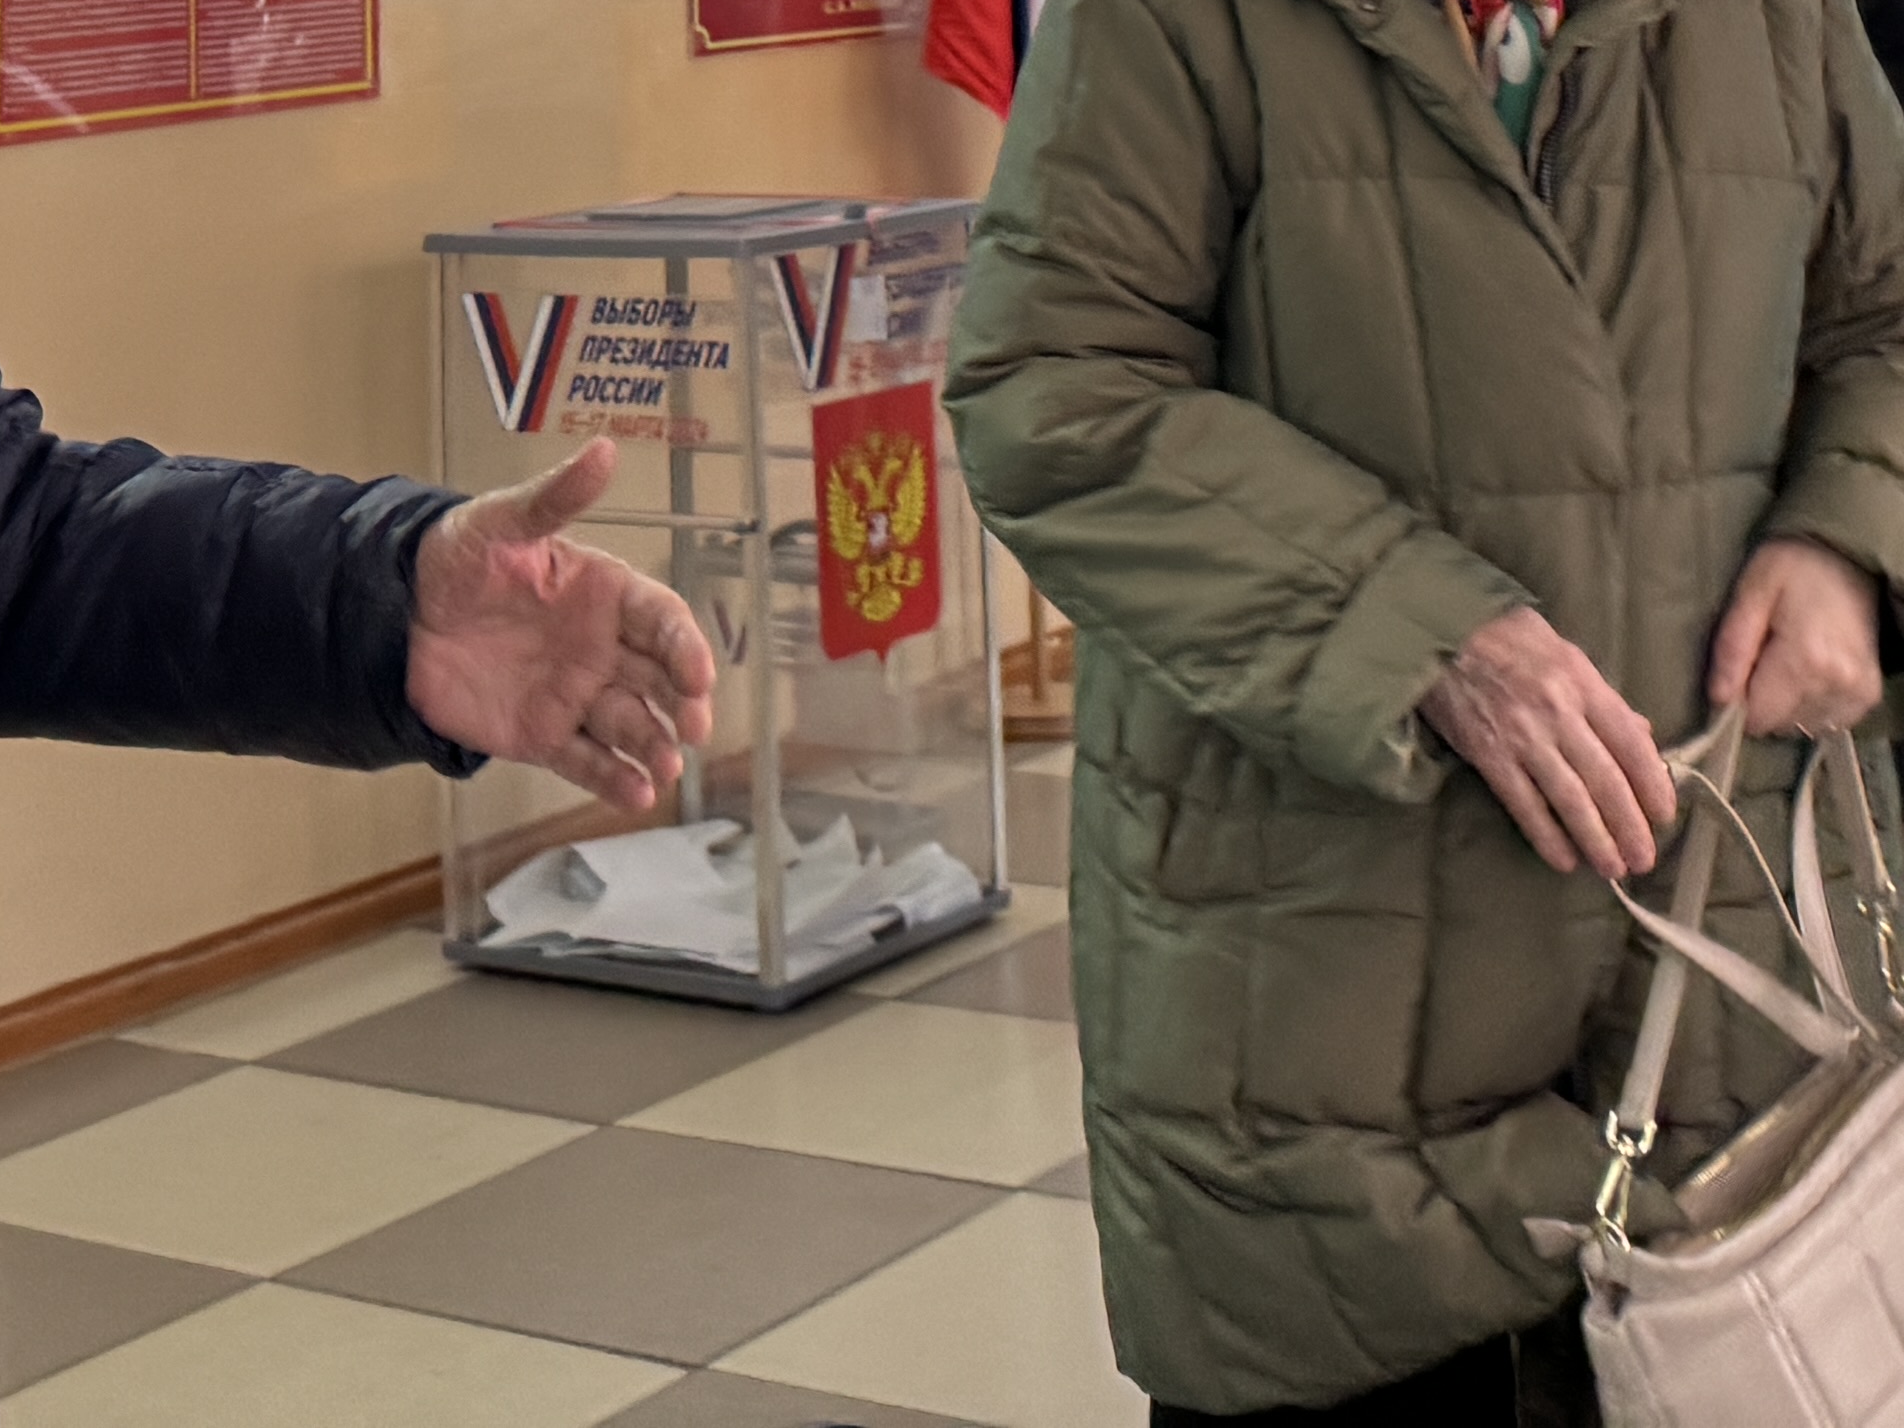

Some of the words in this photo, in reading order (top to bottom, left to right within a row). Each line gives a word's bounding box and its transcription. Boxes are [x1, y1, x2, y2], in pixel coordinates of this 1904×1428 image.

[591, 296, 696, 328] ВЫБОРЫ
[579, 335, 730, 372] ПРЕЗИДЕНТА
[566, 374, 664, 406] РОССИИ
